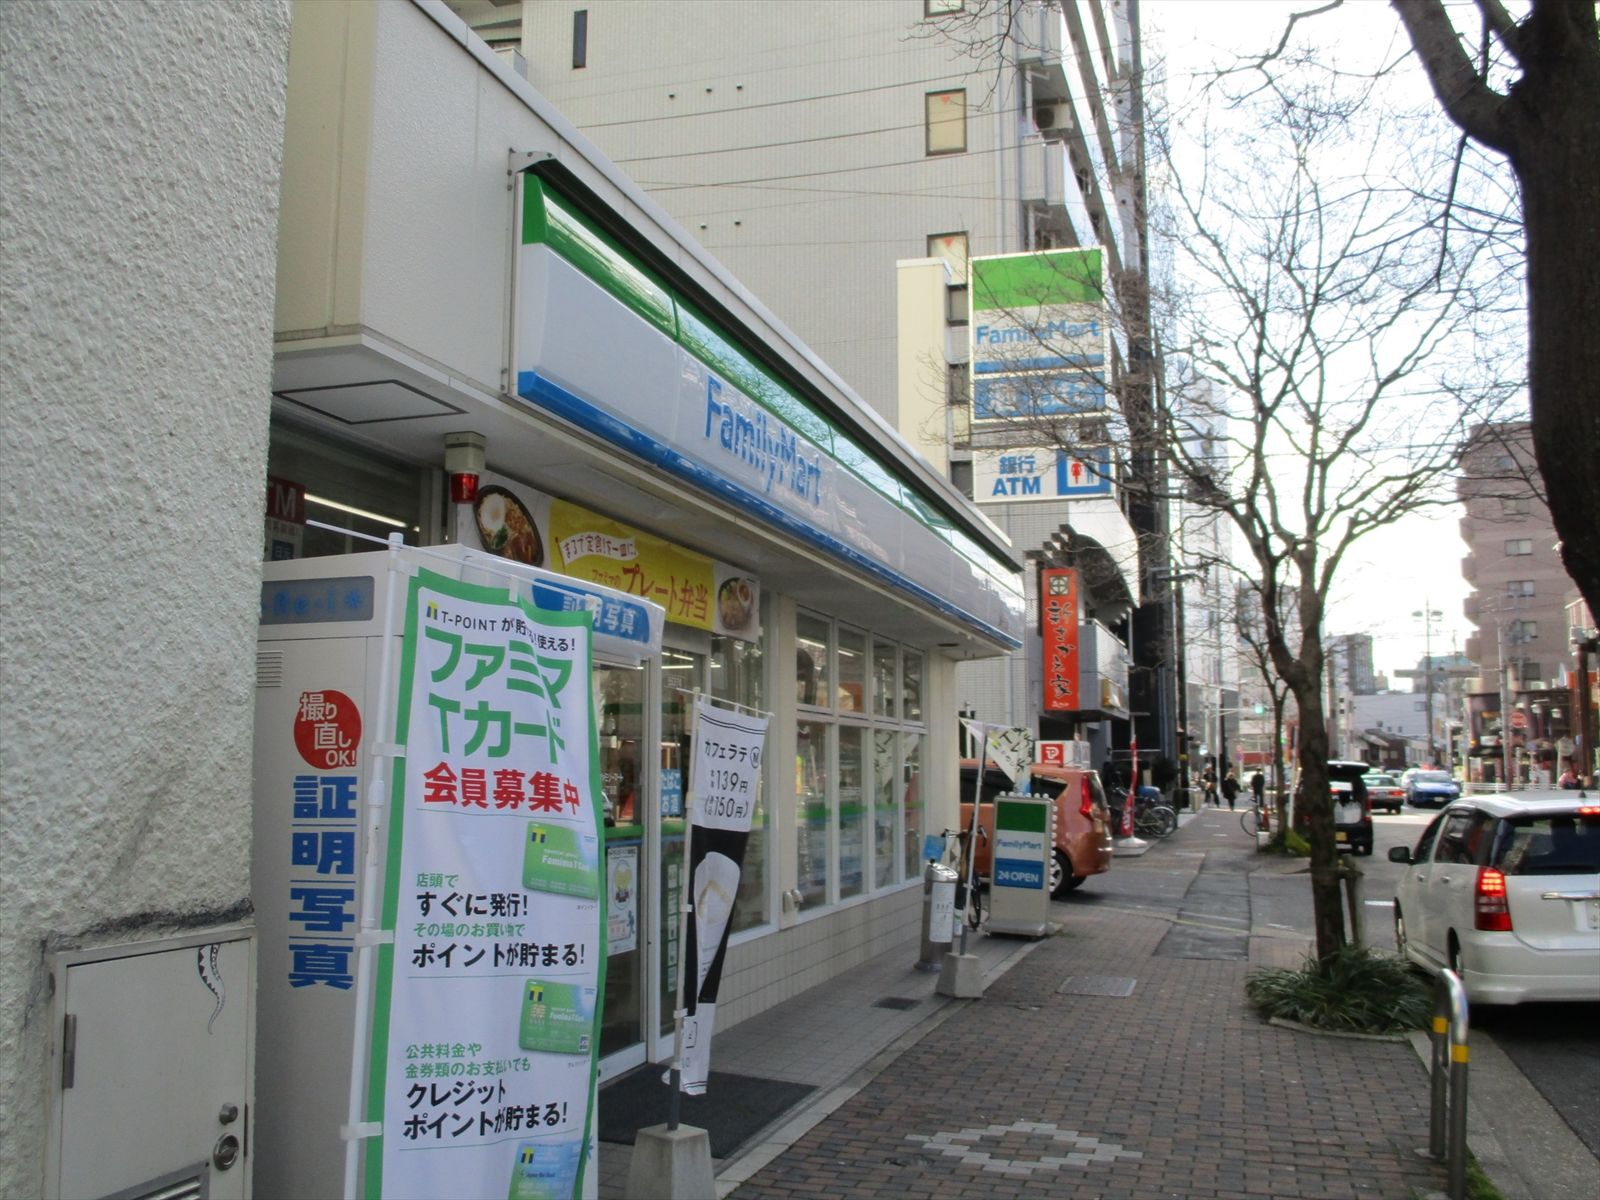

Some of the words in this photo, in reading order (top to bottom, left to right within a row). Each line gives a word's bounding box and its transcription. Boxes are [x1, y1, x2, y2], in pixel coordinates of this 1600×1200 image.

[705, 374, 822, 506] FamilyMart
[998, 455, 1036, 475] 銀行
[992, 476, 1041, 496] ATM
[623, 564, 709, 622] プレート弁当
[441, 610, 497, 631] T-POINT
[425, 625, 573, 709] ファミマ
[300, 692, 337, 722] 撮り
[313, 722, 352, 751] 直し
[428, 692, 565, 764] Tカード
[325, 749, 357, 768] OK!
[705, 741, 747, 762] カフェラテ
[423, 761, 581, 815] 会員募集中
[288, 775, 358, 991] 証明写真
[416, 873, 459, 888] 店頭で
[416, 891, 528, 917] すぐに発行!
[414, 922, 526, 937] その場のお買い物で
[412, 942, 585, 969] ポイントが貯まる!
[405, 1042, 482, 1059] 公共料金や
[405, 1057, 531, 1079] 金券類のお支払いでも
[406, 1079, 506, 1109] クレジット
[403, 1101, 568, 1140] ポイントが貯まる!
